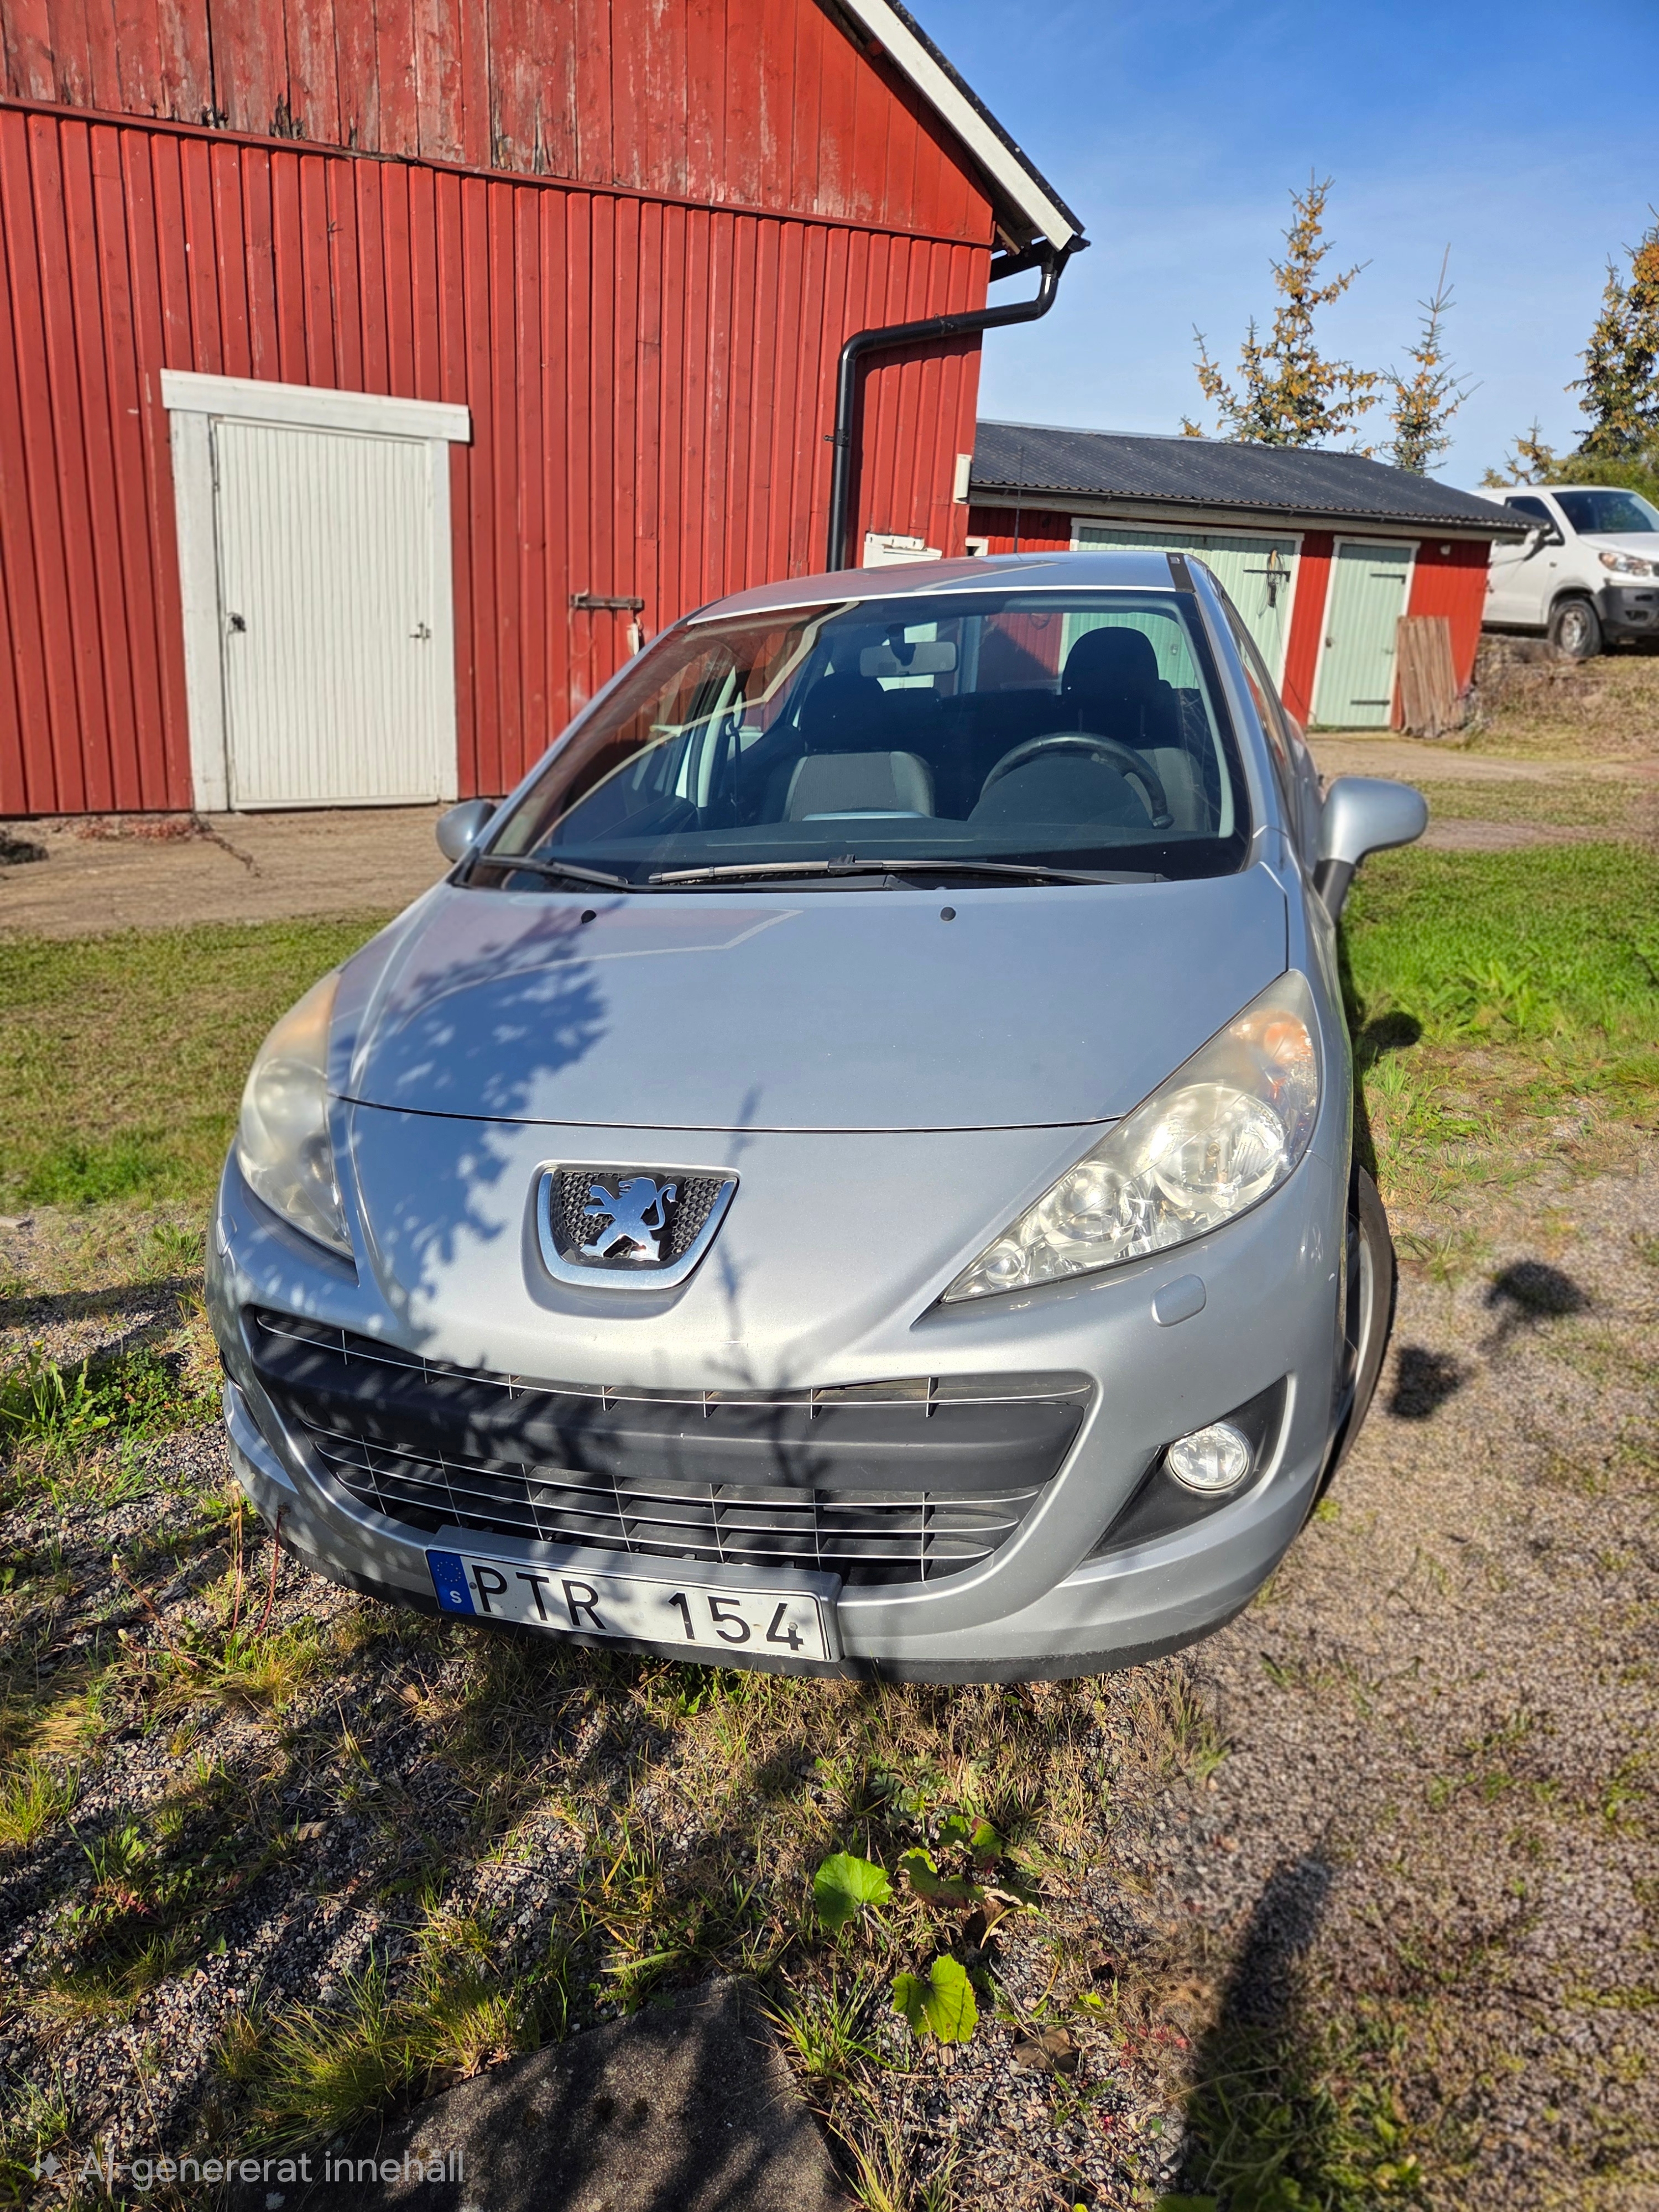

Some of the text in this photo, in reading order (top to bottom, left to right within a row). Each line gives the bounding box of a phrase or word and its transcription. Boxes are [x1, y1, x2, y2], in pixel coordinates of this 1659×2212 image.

[449, 1590, 462, 1604] S
[471, 1564, 804, 1651] PTR 154
